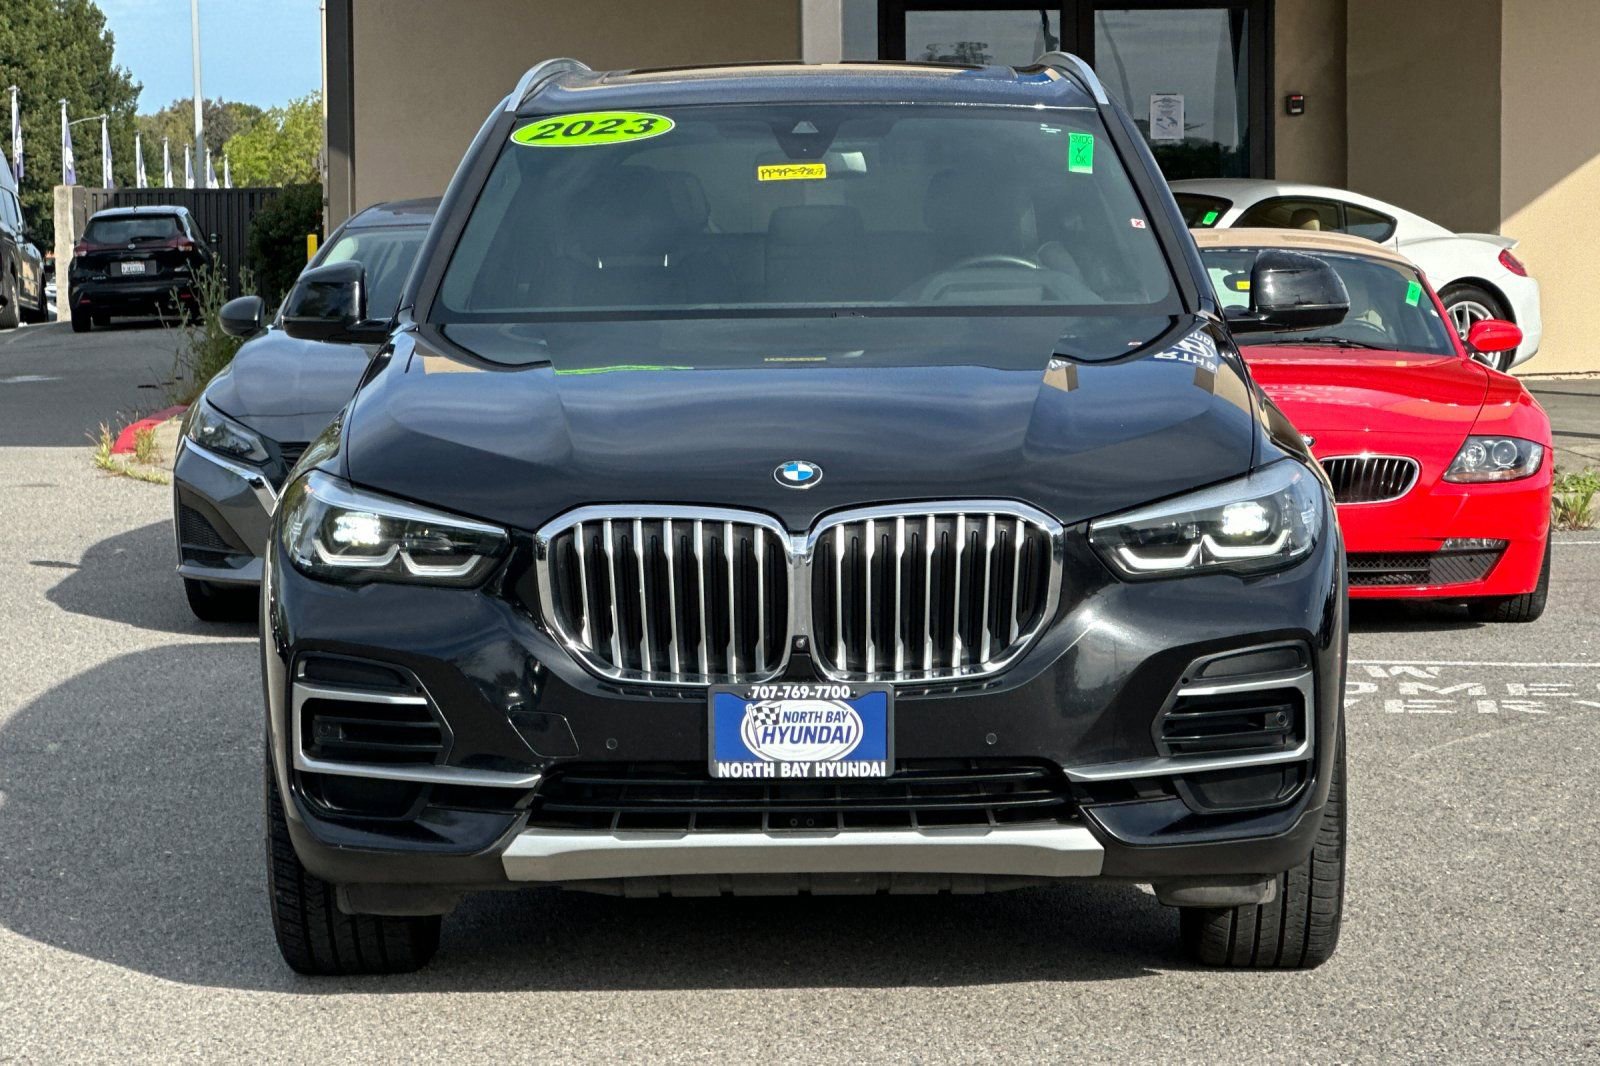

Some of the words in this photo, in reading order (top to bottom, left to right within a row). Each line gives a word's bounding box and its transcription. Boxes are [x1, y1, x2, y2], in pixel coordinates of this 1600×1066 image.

[527, 117, 659, 141] 2023
[751, 685, 851, 699] 707-769-7700
[782, 711, 822, 724] NORTH
[825, 711, 849, 723] BAY
[761, 725, 852, 745] HYUNDAI
[718, 762, 775, 778] NORTH
[781, 762, 810, 777] BAY
[815, 761, 886, 777] HYUNDAI
